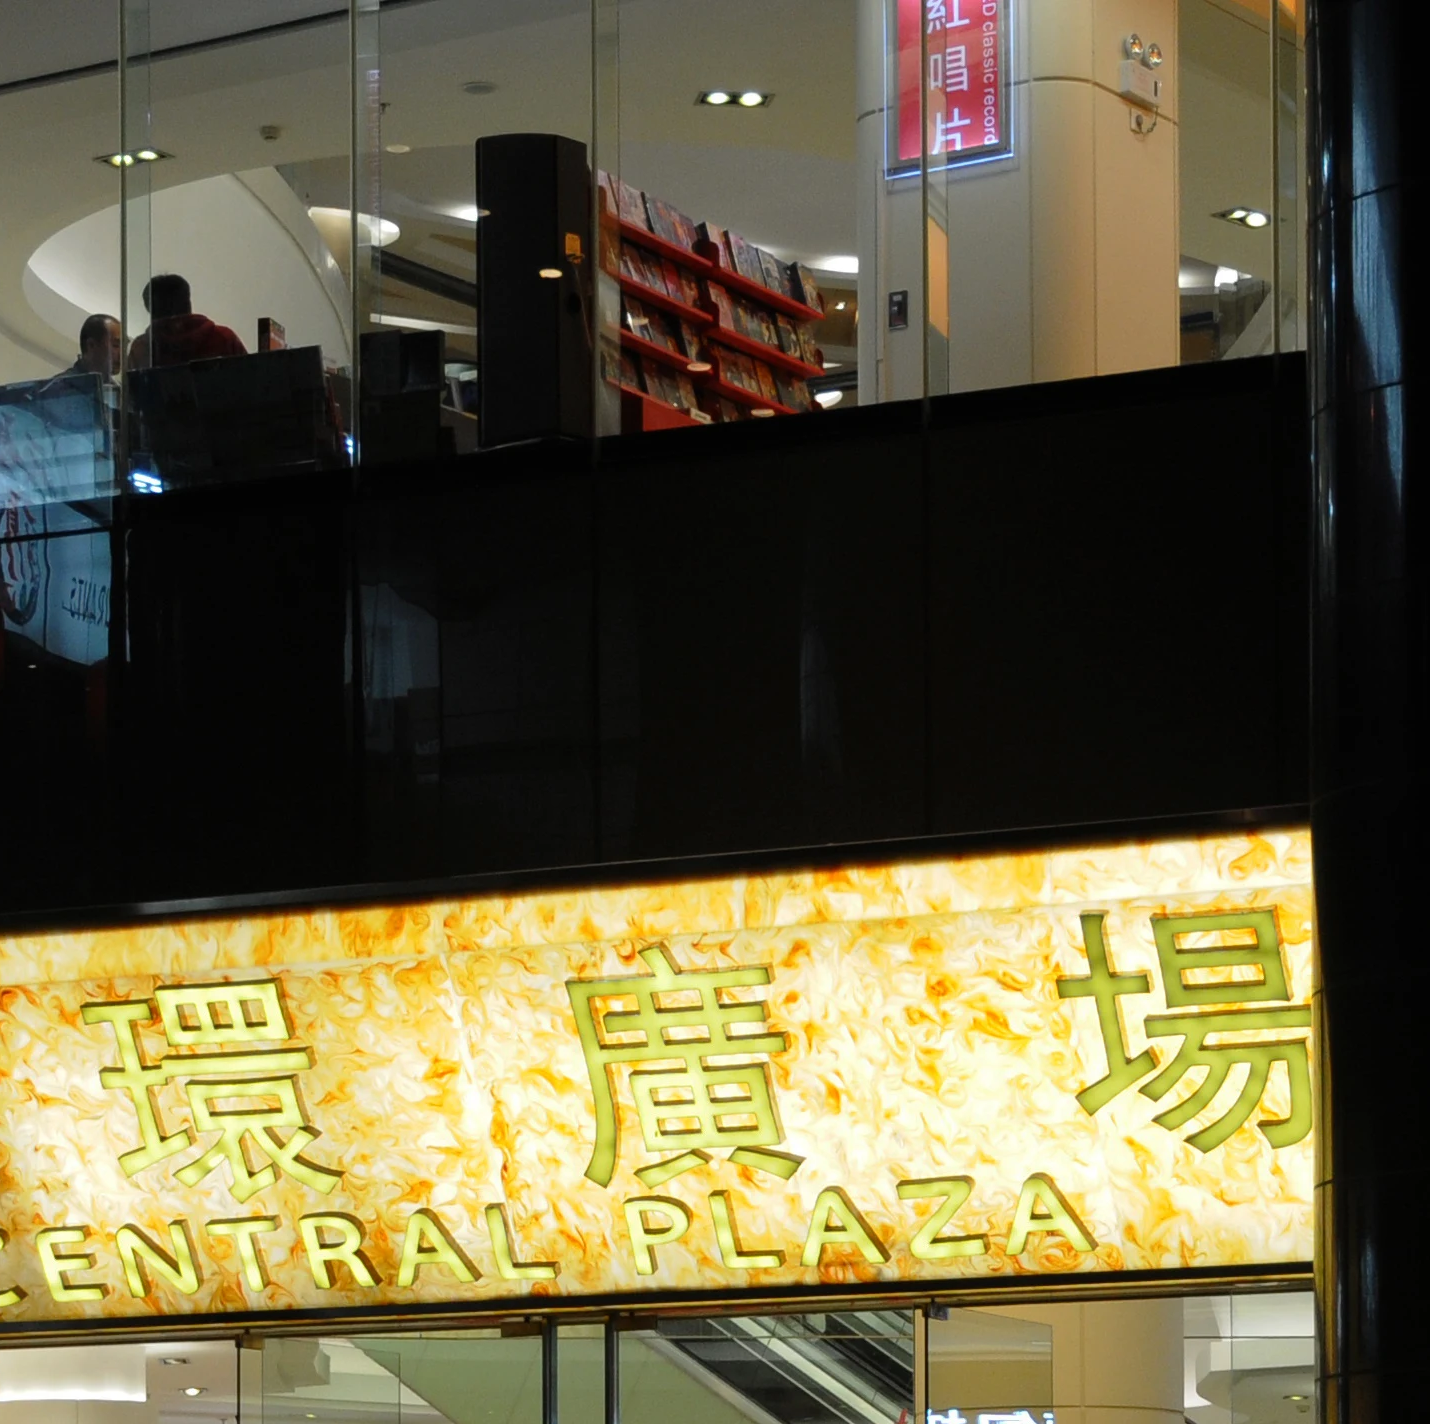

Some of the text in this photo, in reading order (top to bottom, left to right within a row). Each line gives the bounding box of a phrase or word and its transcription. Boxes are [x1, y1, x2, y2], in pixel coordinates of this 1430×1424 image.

[982, 22, 998, 83] classic
[983, 88, 1000, 145] record
[622, 1171, 1099, 1276] PLAZA
